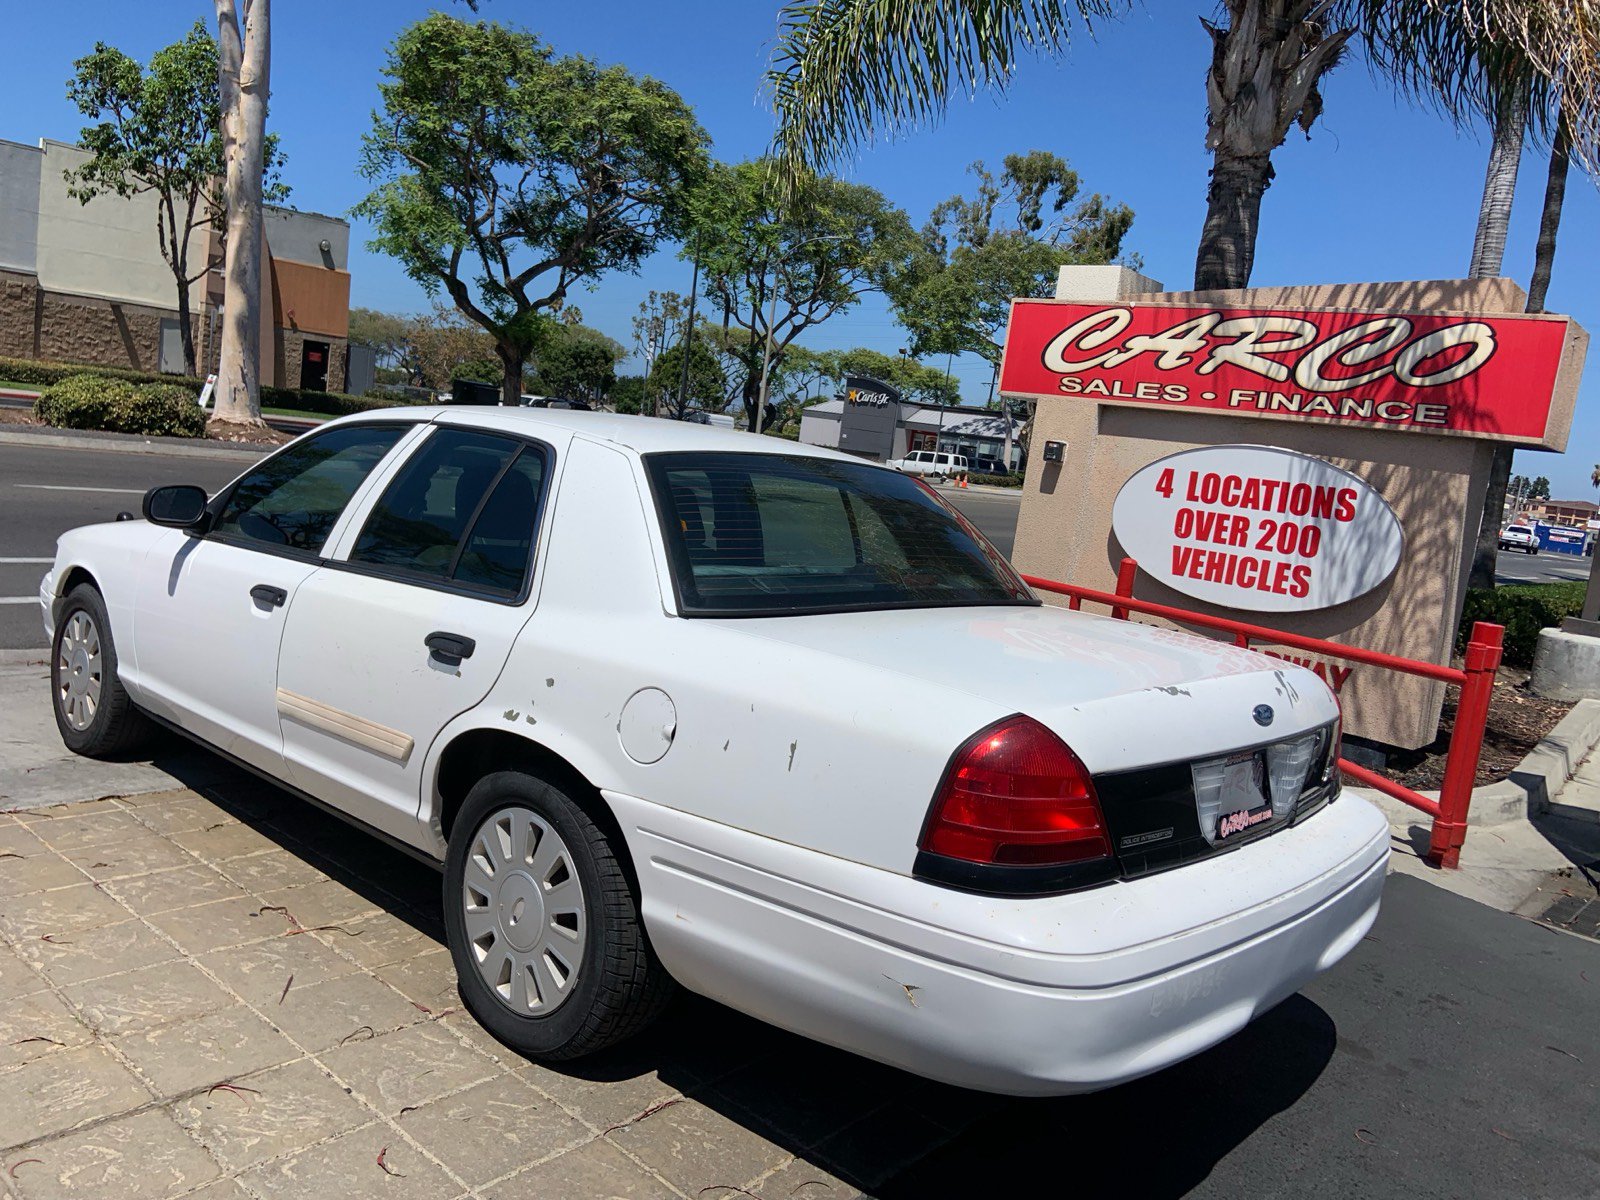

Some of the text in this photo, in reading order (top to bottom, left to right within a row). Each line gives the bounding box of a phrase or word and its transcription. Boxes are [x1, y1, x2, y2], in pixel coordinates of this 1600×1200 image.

[1042, 308, 1498, 393] CARCO
[856, 391, 890, 405] Carl's Jr.
[1059, 376, 1451, 424] SALES FINANCE
[1155, 468, 1358, 522] 4 LOCATIONS
[1174, 507, 1321, 558] OVER 200
[1171, 545, 1312, 598] VEHICLES
